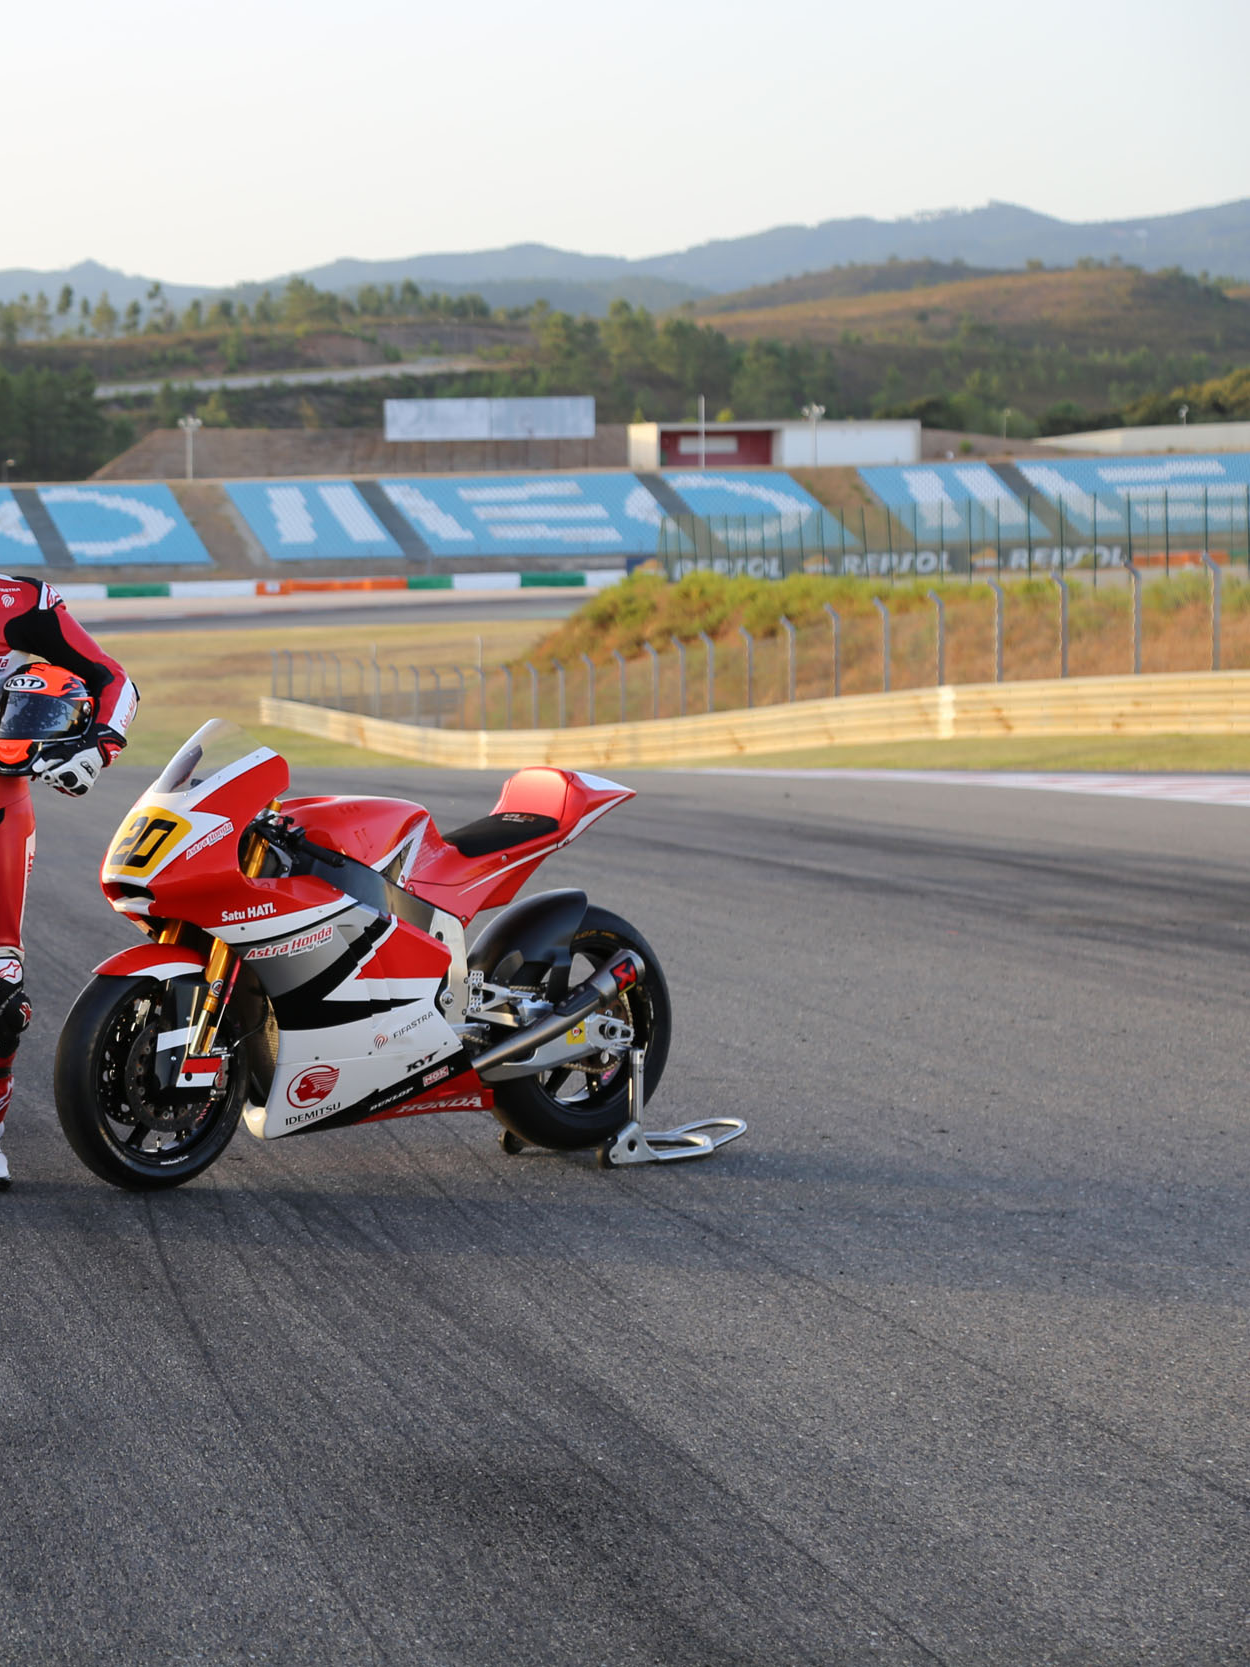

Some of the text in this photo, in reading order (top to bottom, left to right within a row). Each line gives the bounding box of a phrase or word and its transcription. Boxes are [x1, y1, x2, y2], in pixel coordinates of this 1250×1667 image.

[839, 551, 952, 575] REPSOL
[9, 677, 43, 688] KYT
[110, 816, 177, 868] 20
[221, 902, 276, 922] Satu HATI.
[246, 926, 333, 959] Astra Honda
[393, 1011, 434, 1039] FIFASTRA
[406, 1049, 441, 1073] KYT
[424, 1067, 448, 1084] NGK
[370, 1087, 414, 1111] DUNLOP
[396, 1096, 483, 1113] HONDA
[285, 1102, 341, 1126] IDEMITSU
